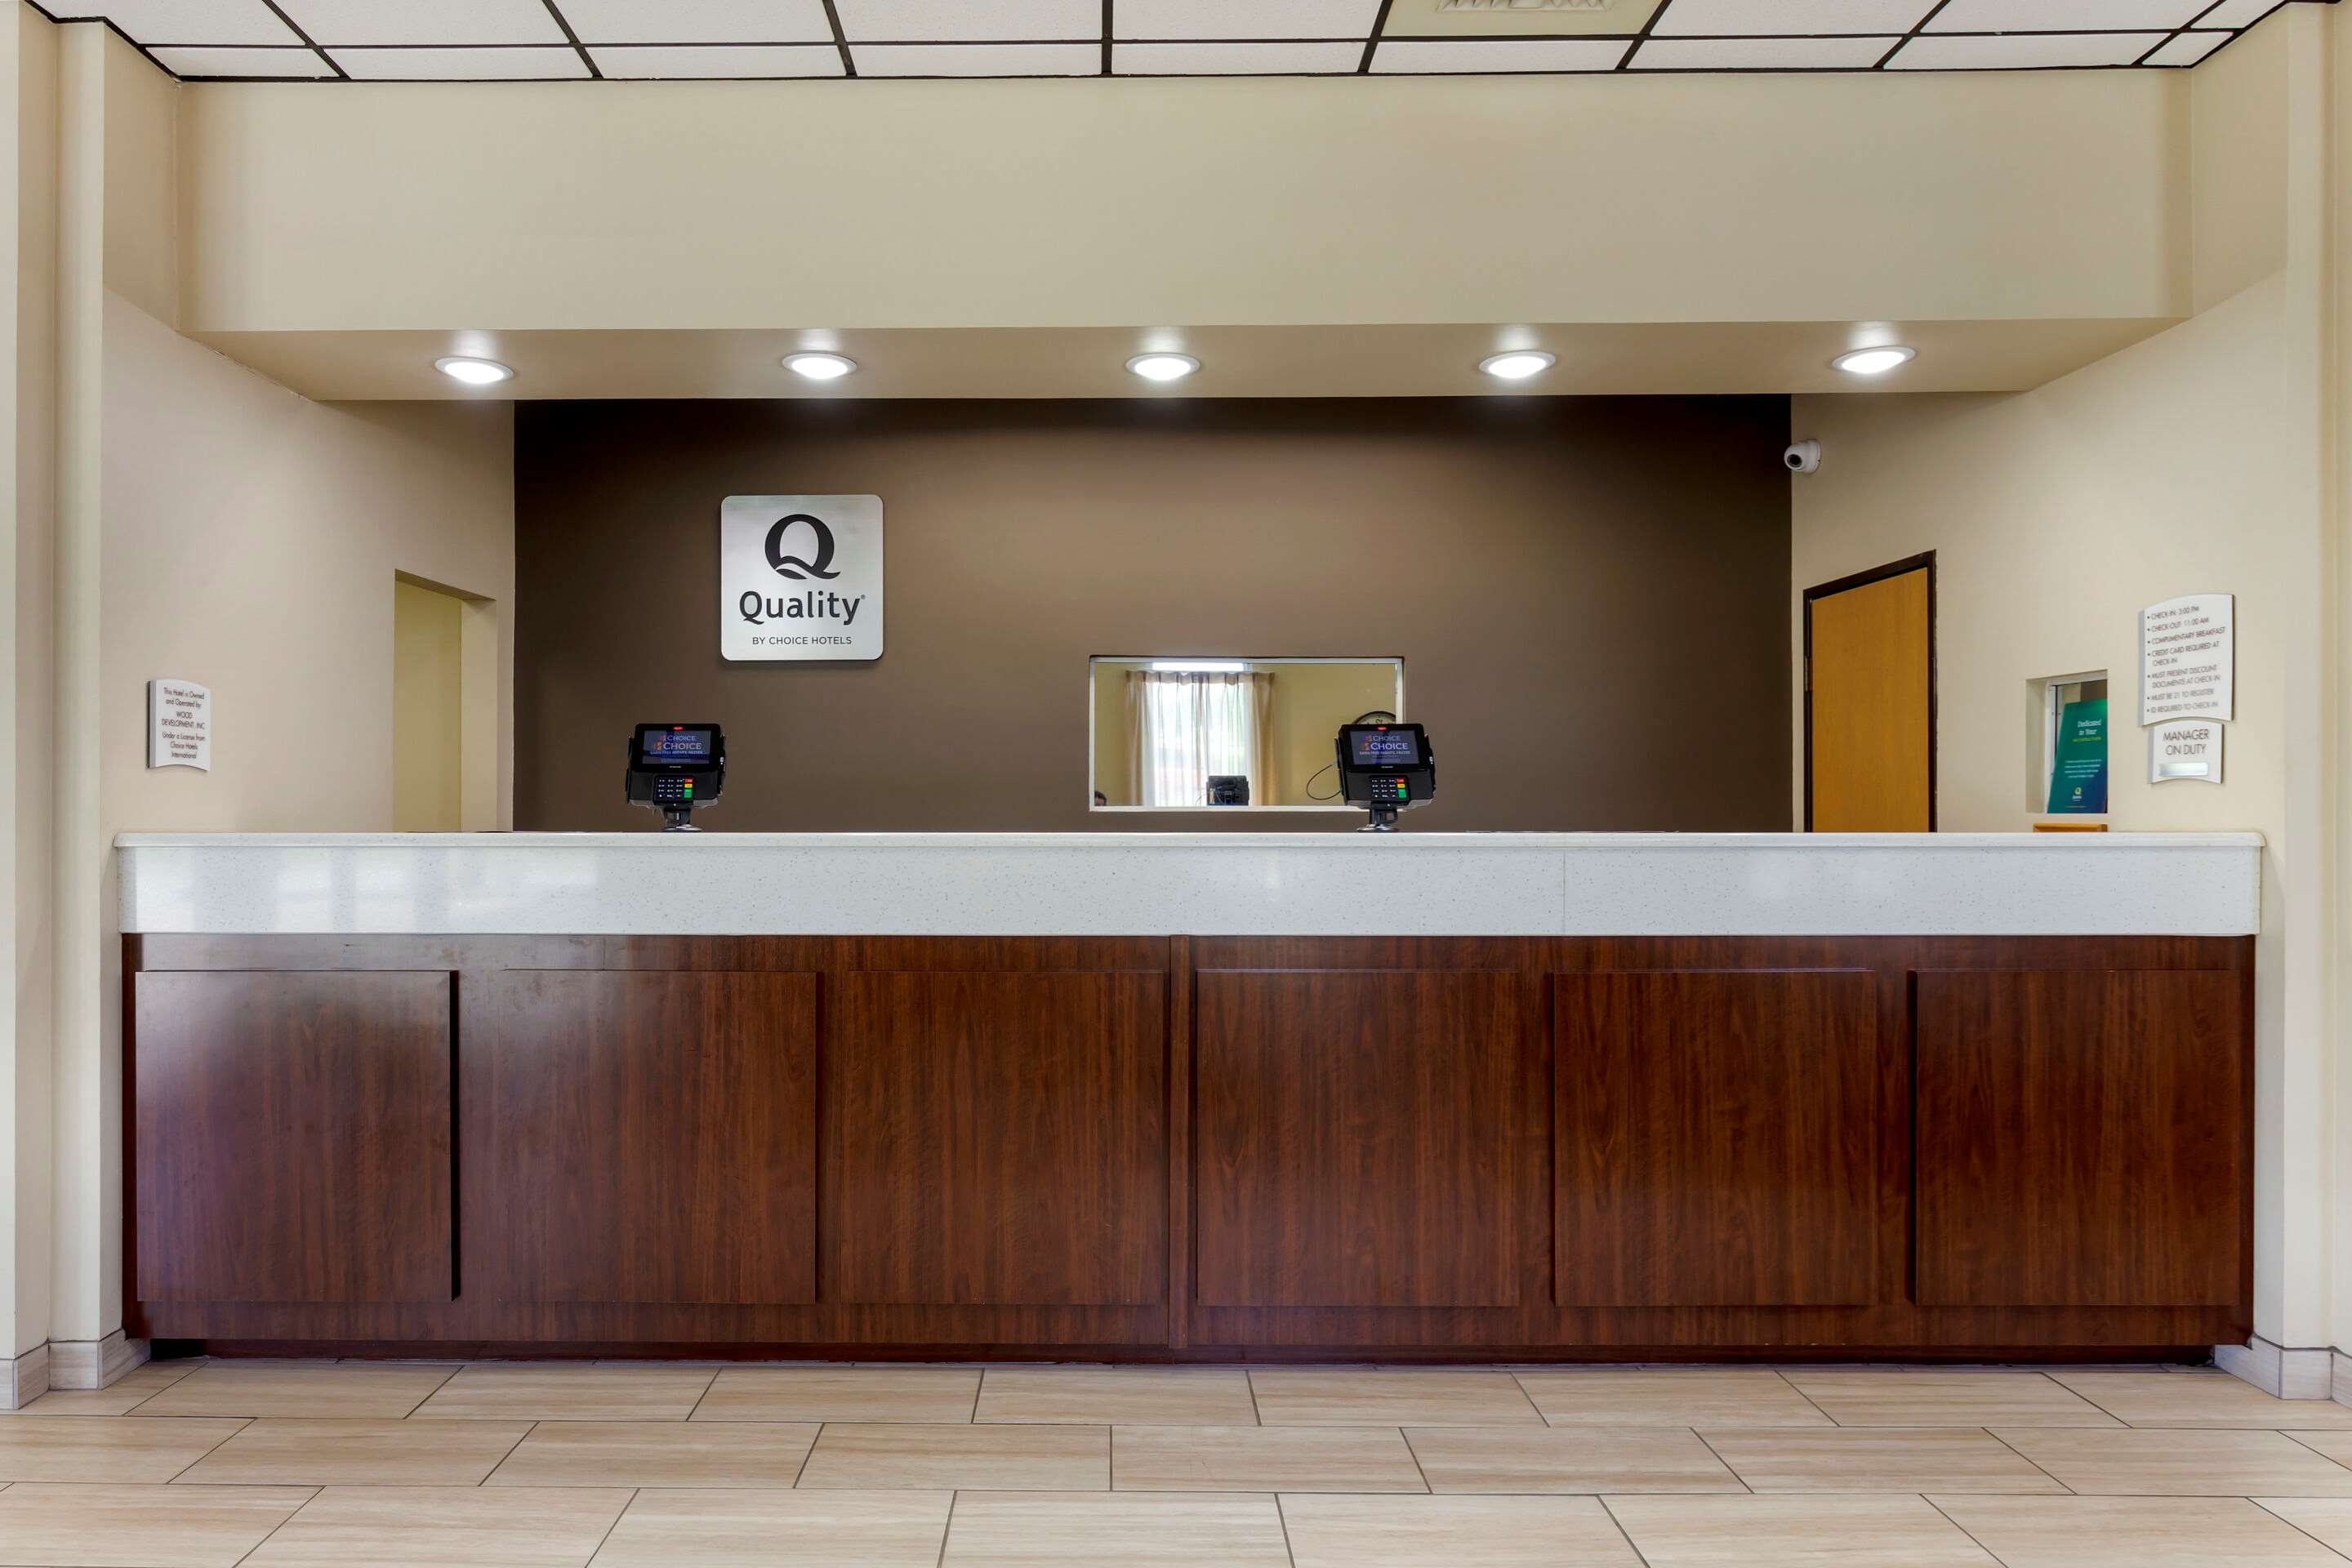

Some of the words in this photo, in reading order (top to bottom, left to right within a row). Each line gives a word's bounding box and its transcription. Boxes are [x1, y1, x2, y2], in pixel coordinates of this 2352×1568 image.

[764, 514, 842, 580] Q
[739, 590, 862, 626] Quality
[2151, 612, 2167, 620] CHECK
[2152, 624, 2169, 632] CHECK
[2195, 626, 2225, 637] BREAKFAST
[752, 636, 765, 644] BY
[768, 636, 808, 644] CHOICE
[811, 636, 852, 644] HOTELS
[2152, 648, 2169, 657] CREDIT
[2170, 646, 2185, 654] CARD
[2185, 642, 2212, 652] REQUIRED
[2152, 658, 2169, 666] CHECK
[2151, 670, 2165, 679] MUST
[2166, 668, 2189, 677] PRESENT
[2189, 664, 2217, 675] DISCOUNT
[2152, 678, 2185, 688] DOCUMENTS
[2194, 675, 2212, 684] CHECK
[2151, 693, 2165, 701] MUST
[2163, 728, 2209, 742] MANAGER
[2165, 744, 2181, 755] ON
[2183, 743, 2207, 755] DUTY
